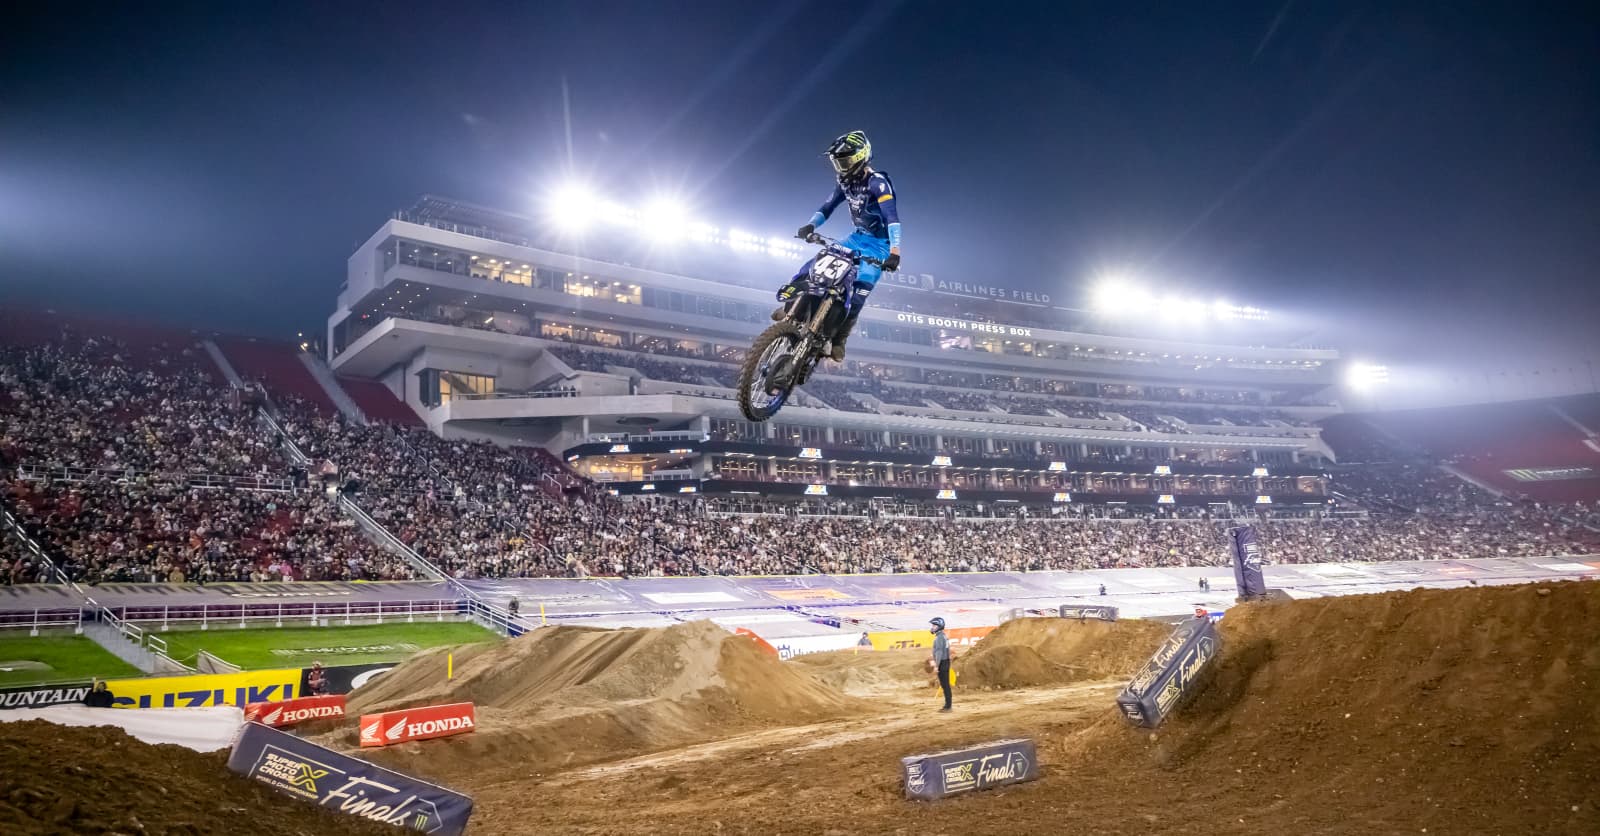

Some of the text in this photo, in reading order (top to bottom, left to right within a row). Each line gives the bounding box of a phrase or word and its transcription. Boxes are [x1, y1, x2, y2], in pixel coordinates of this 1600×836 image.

[814, 255, 849, 280] 43
[938, 281, 1006, 298] AIRLINES
[1012, 289, 1051, 303] FIELD
[897, 313, 1032, 337] OTIS BOOTH PRESS BOX
[1178, 642, 1207, 693] Finals
[282, 705, 344, 722] HONDA
[407, 716, 474, 737] HONDA
[264, 760, 298, 776] MOTO
[265, 753, 301, 770] SUPER
[977, 752, 1015, 788] Finals
[258, 765, 297, 784] CROSS
[318, 776, 417, 827] Finals
